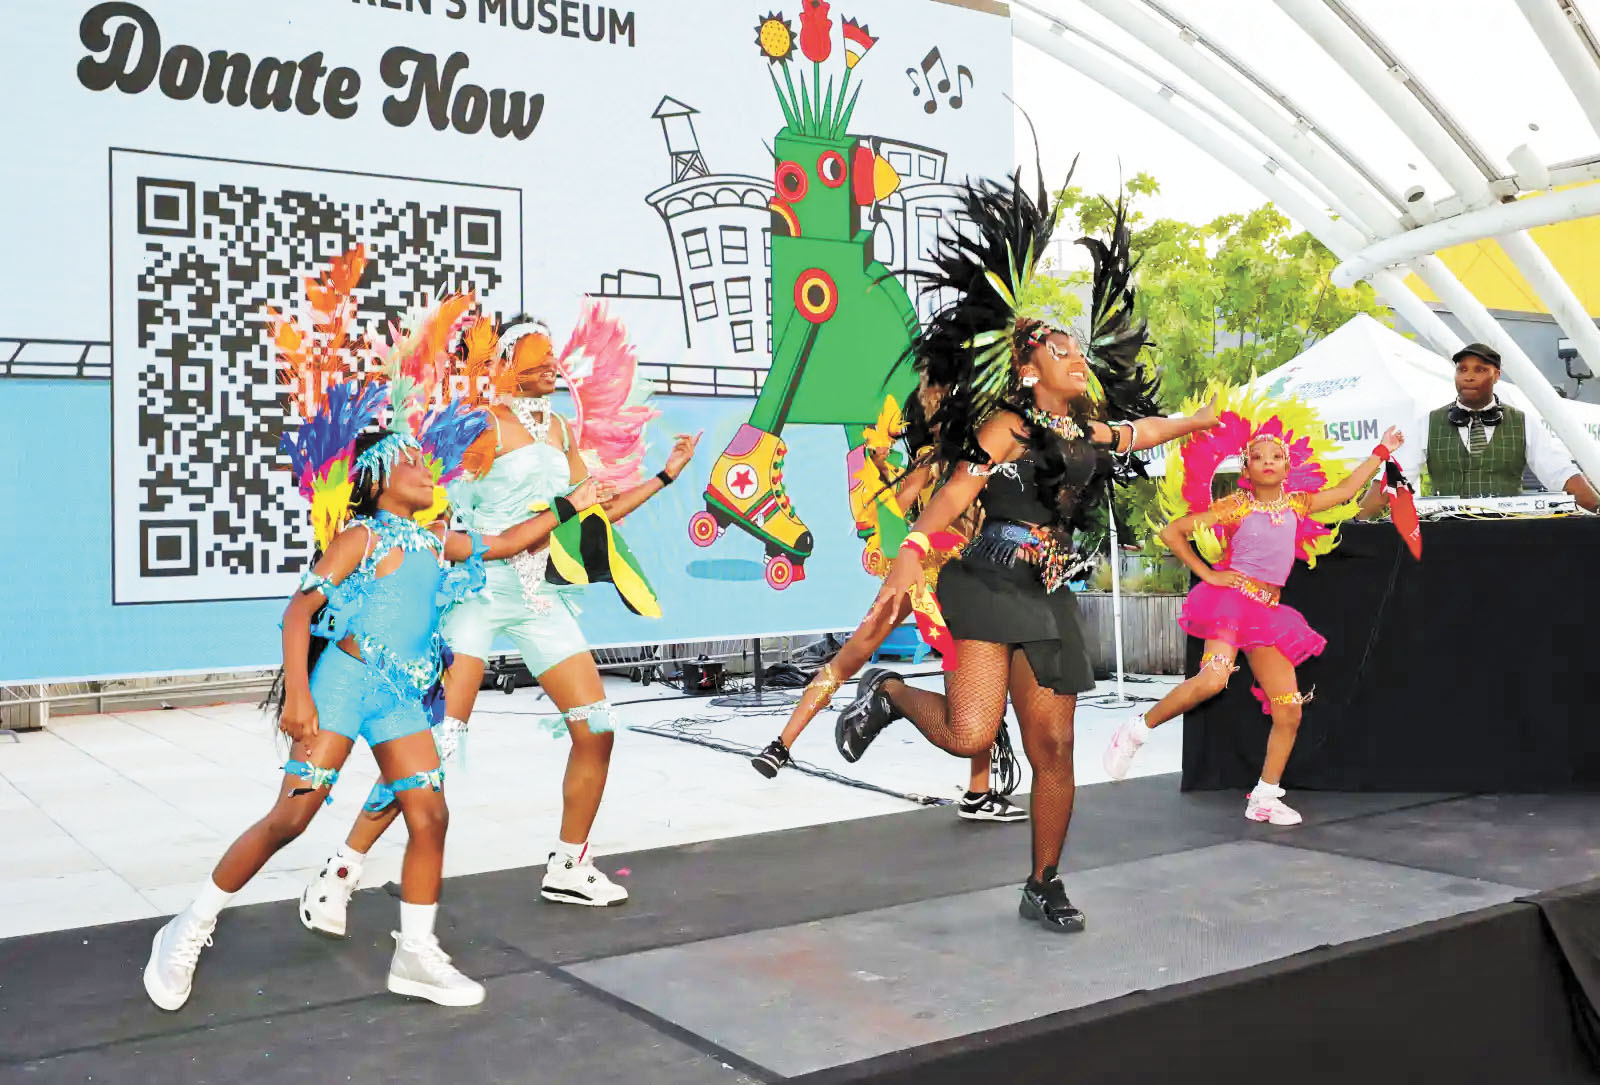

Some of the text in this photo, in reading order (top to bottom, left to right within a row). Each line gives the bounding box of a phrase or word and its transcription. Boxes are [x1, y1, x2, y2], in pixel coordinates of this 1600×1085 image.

[479, 0, 635, 47] MUSEUM
[77, 1, 545, 140] Donate Now
